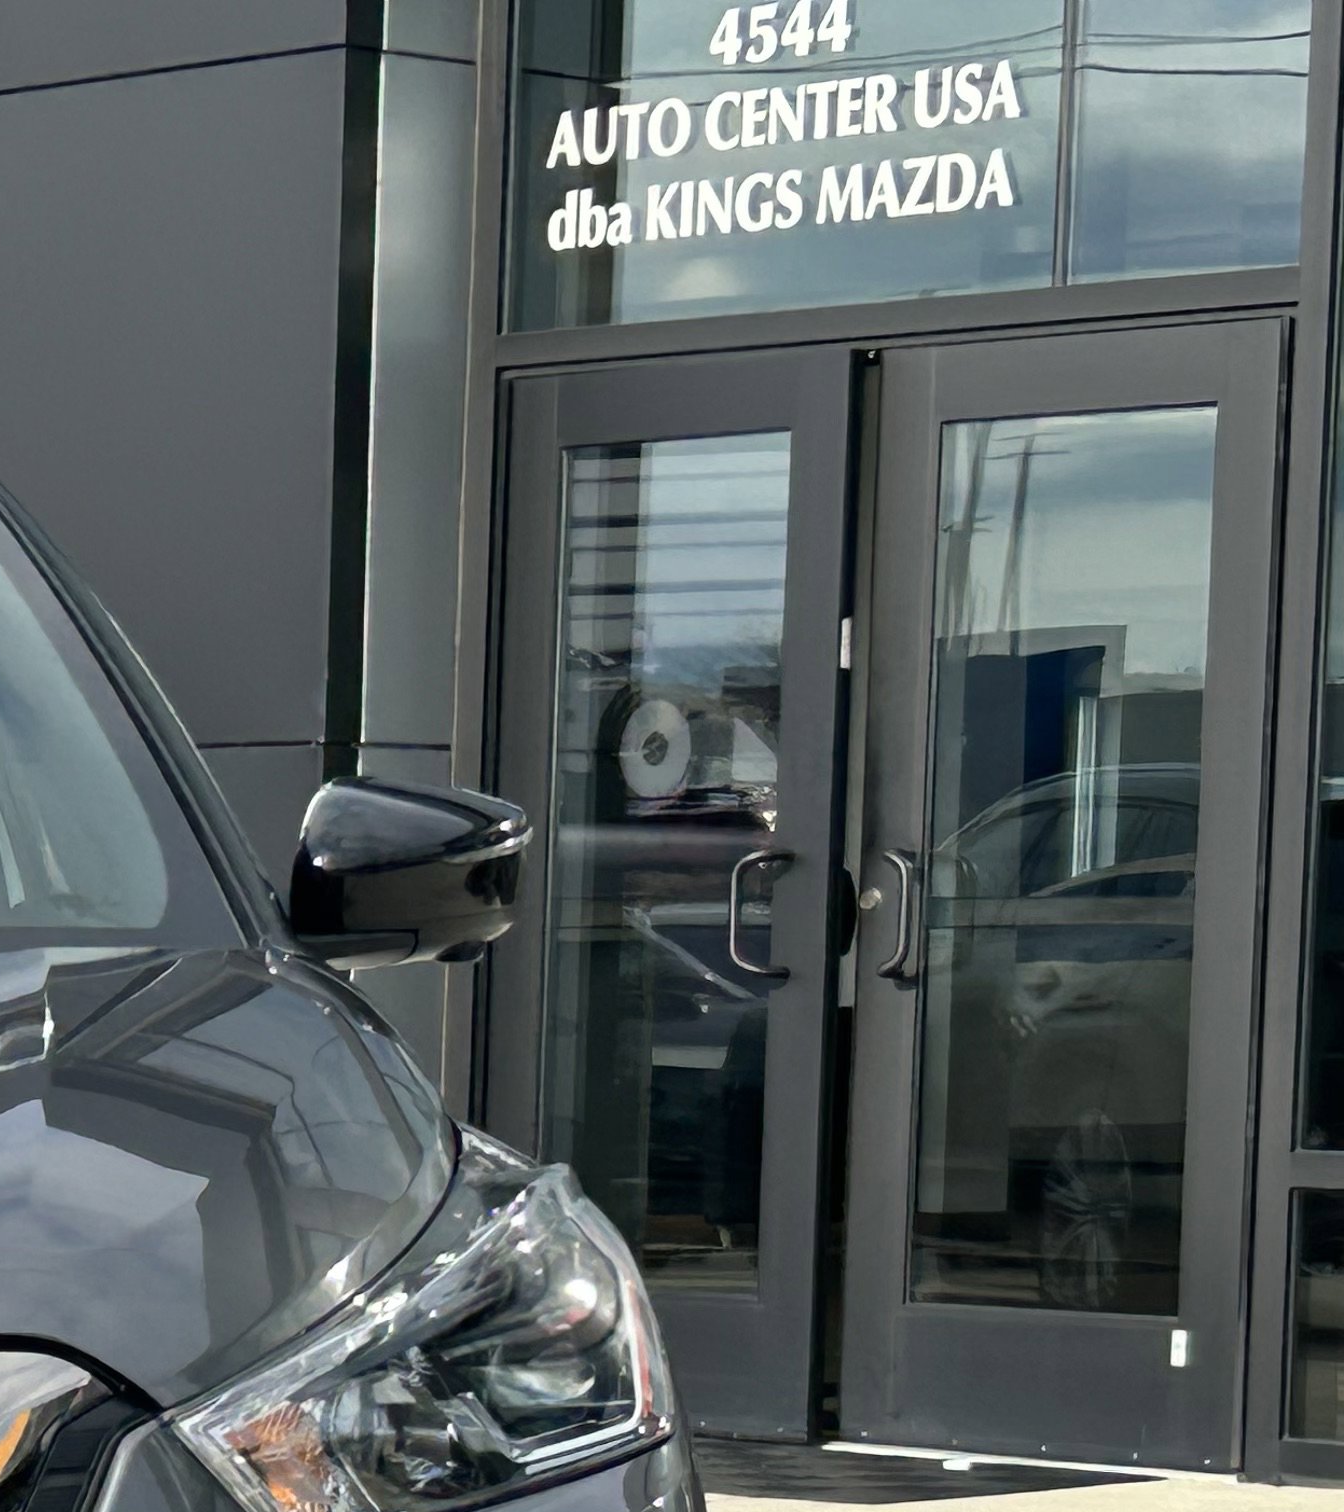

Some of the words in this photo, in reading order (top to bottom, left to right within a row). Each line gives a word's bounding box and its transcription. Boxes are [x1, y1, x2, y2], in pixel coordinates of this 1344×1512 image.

[709, 0, 852, 66] 4544
[545, 97, 692, 169] AUTO
[704, 74, 898, 151] CENTER
[914, 59, 1021, 129] USA
[547, 187, 634, 252] dba
[644, 169, 804, 242] KINGS
[815, 148, 1014, 225] MAZDA
